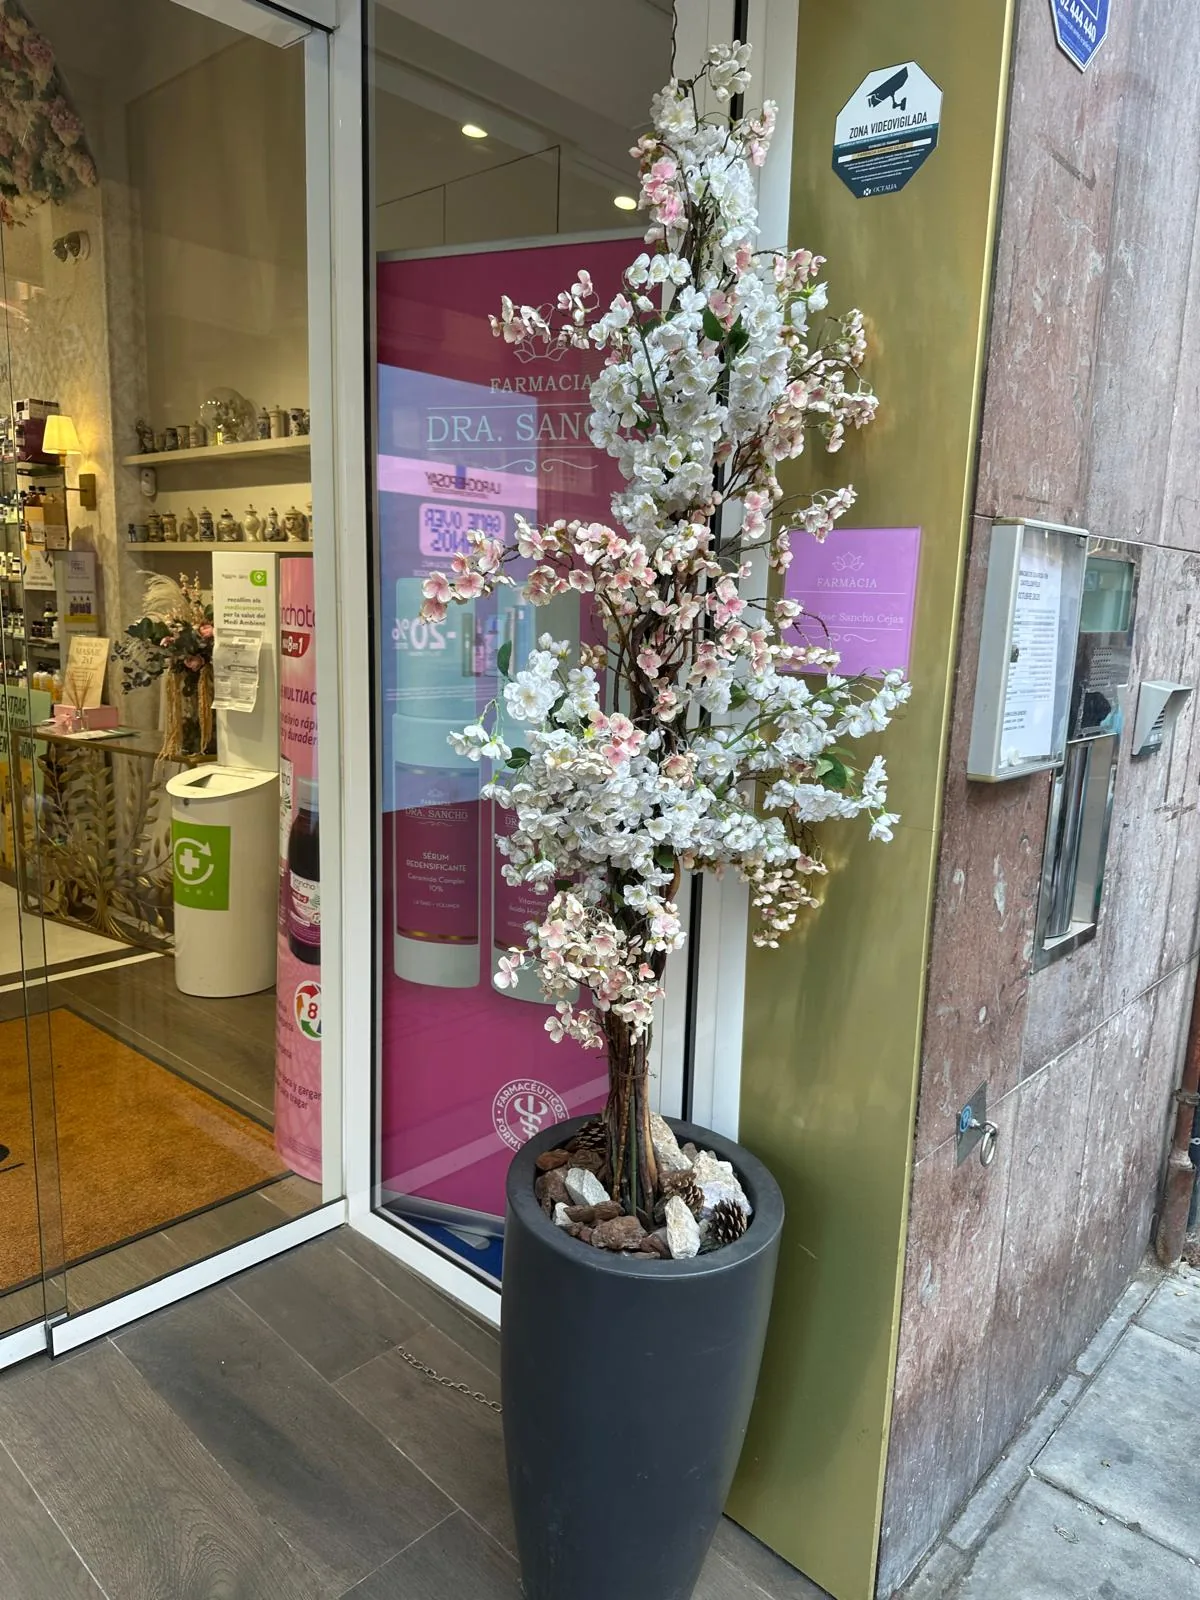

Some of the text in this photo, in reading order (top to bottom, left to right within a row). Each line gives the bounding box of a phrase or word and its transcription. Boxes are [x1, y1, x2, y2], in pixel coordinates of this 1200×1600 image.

[849, 126, 869, 140] ZONA
[871, 111, 928, 133] VIDEOVIGILADA
[490, 374, 593, 394] FARMACIA
[427, 412, 598, 442] DRA. SAN
[839, 611, 874, 622] Sancho
[428, 809, 469, 820] SANCHO
[406, 859, 467, 872] REDENSIFICANTE
[308, 1002, 318, 1020] 8
[496, 1080, 566, 1120] FARMACÉUTICOS
